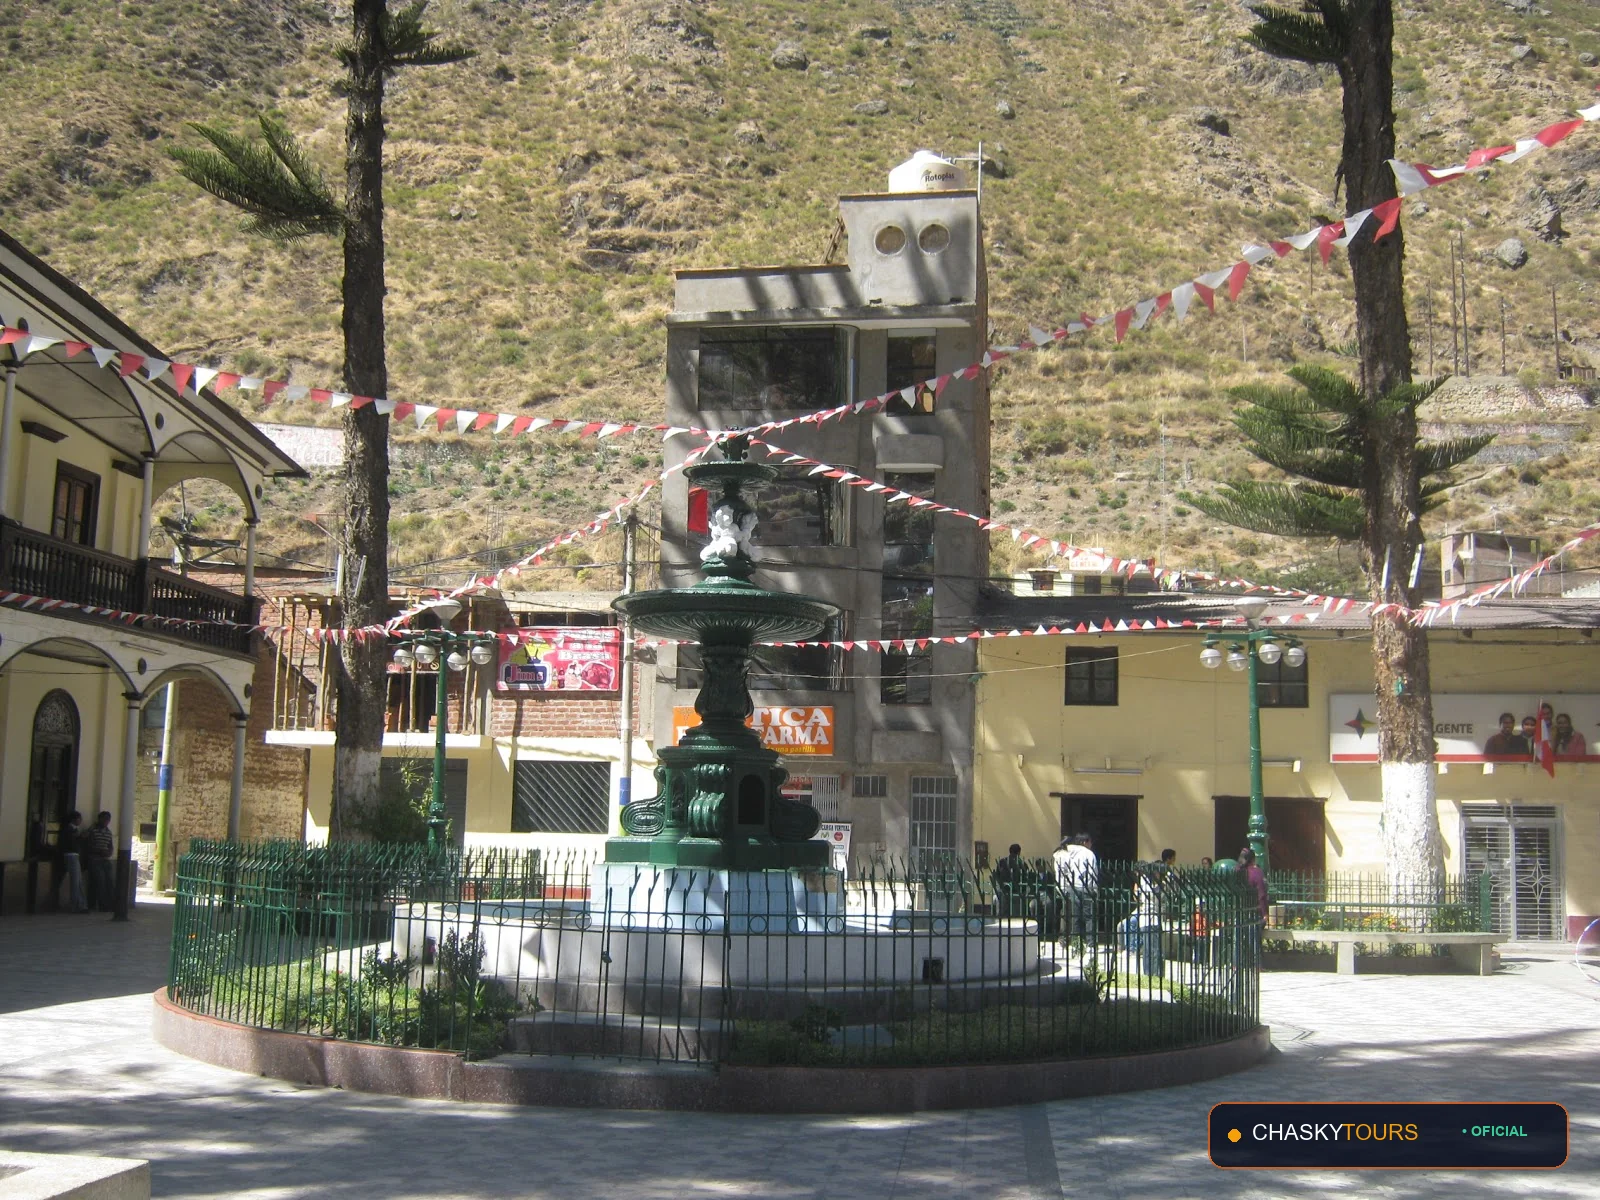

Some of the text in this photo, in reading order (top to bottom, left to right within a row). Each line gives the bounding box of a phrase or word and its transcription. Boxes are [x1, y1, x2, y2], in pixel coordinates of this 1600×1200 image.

[925, 172, 955, 182] Rotoplas
[559, 651, 612, 661] Brasa
[750, 707, 830, 727] TICA
[1434, 723, 1473, 734] GENTE
